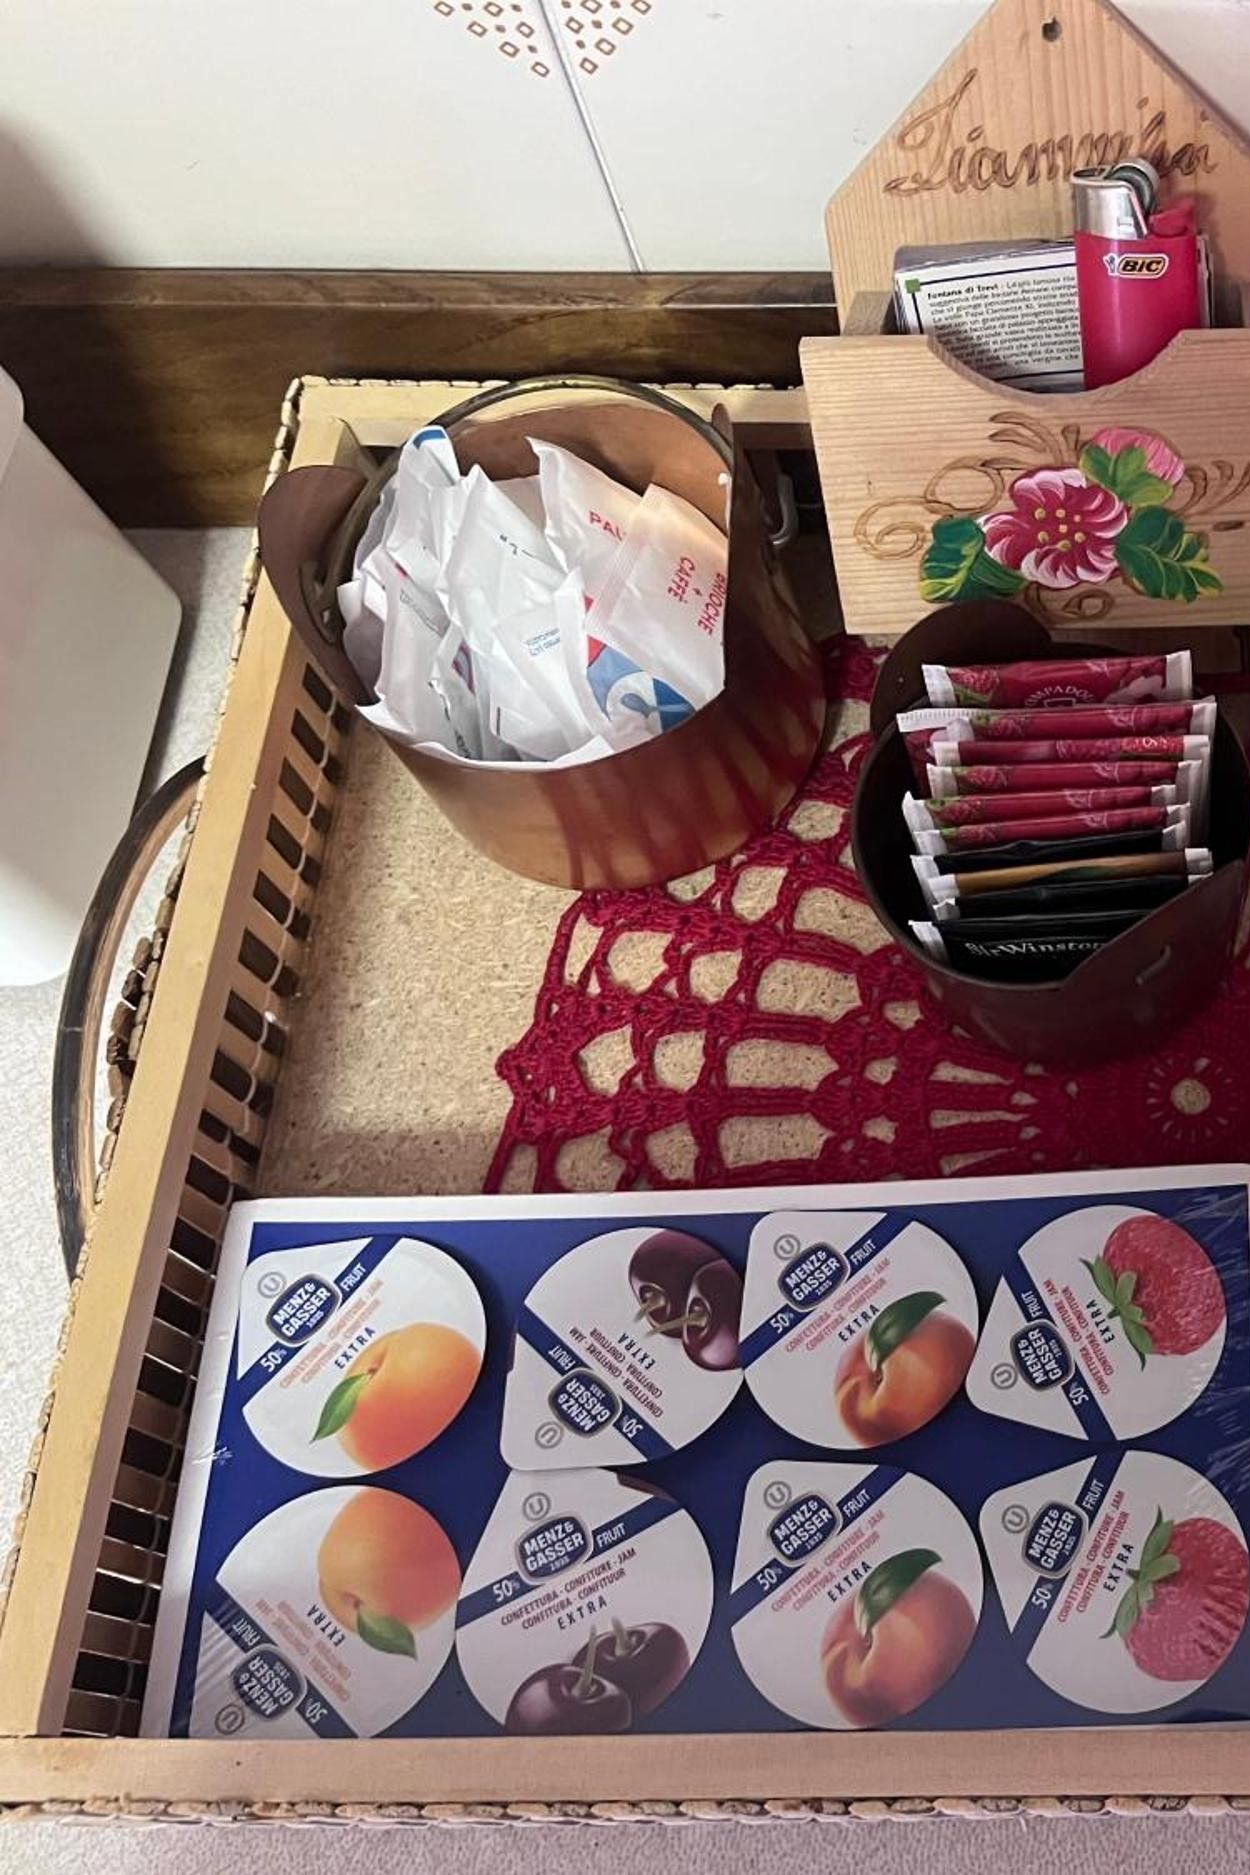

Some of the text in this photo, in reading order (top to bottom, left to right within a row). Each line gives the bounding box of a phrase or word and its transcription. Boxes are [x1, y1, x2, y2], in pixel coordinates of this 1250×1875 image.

[1122, 260, 1162, 273] BIC
[785, 1250, 827, 1288] MENZ&
[850, 1239, 876, 1266] FRUIT
[340, 1262, 367, 1291] FRUIT
[792, 1257, 841, 1301] GASSER
[273, 1282, 316, 1325] MENZ&
[281, 1287, 331, 1338] GASSER
[838, 1304, 880, 1342] EXTRA
[1021, 1290, 1043, 1318] FRUIT
[1086, 1299, 1116, 1344] EXTRA
[334, 1326, 376, 1369] EXTRA
[547, 1345, 576, 1371] FRUIT
[618, 1332, 656, 1371] EXTRA
[1017, 1339, 1048, 1384] MENZ&
[1028, 1329, 1063, 1381] GASSER
[557, 1392, 596, 1432] MENZ&
[566, 1378, 611, 1422] GASSER
[842, 1488, 871, 1517] FRUIT
[1082, 1479, 1105, 1510] FRUIT
[523, 1521, 575, 1556] MENZ&
[596, 1522, 627, 1548] FRUIT
[774, 1499, 819, 1541] MENZ&
[780, 1508, 833, 1555] GASSER
[1028, 1508, 1060, 1558] MENZ&
[1040, 1511, 1077, 1569] GASSER
[525, 1532, 584, 1572] GASSER
[617, 1547, 637, 1565] JAM
[1103, 1543, 1135, 1592] EXTRA
[827, 1560, 872, 1602] EXTRA
[232, 1617, 260, 1646] FRUIT
[307, 1603, 346, 1647] EXTRA
[557, 1595, 608, 1630] EXTRA
[239, 1672, 279, 1716] MENZ&
[248, 1656, 295, 1706] GASSER
